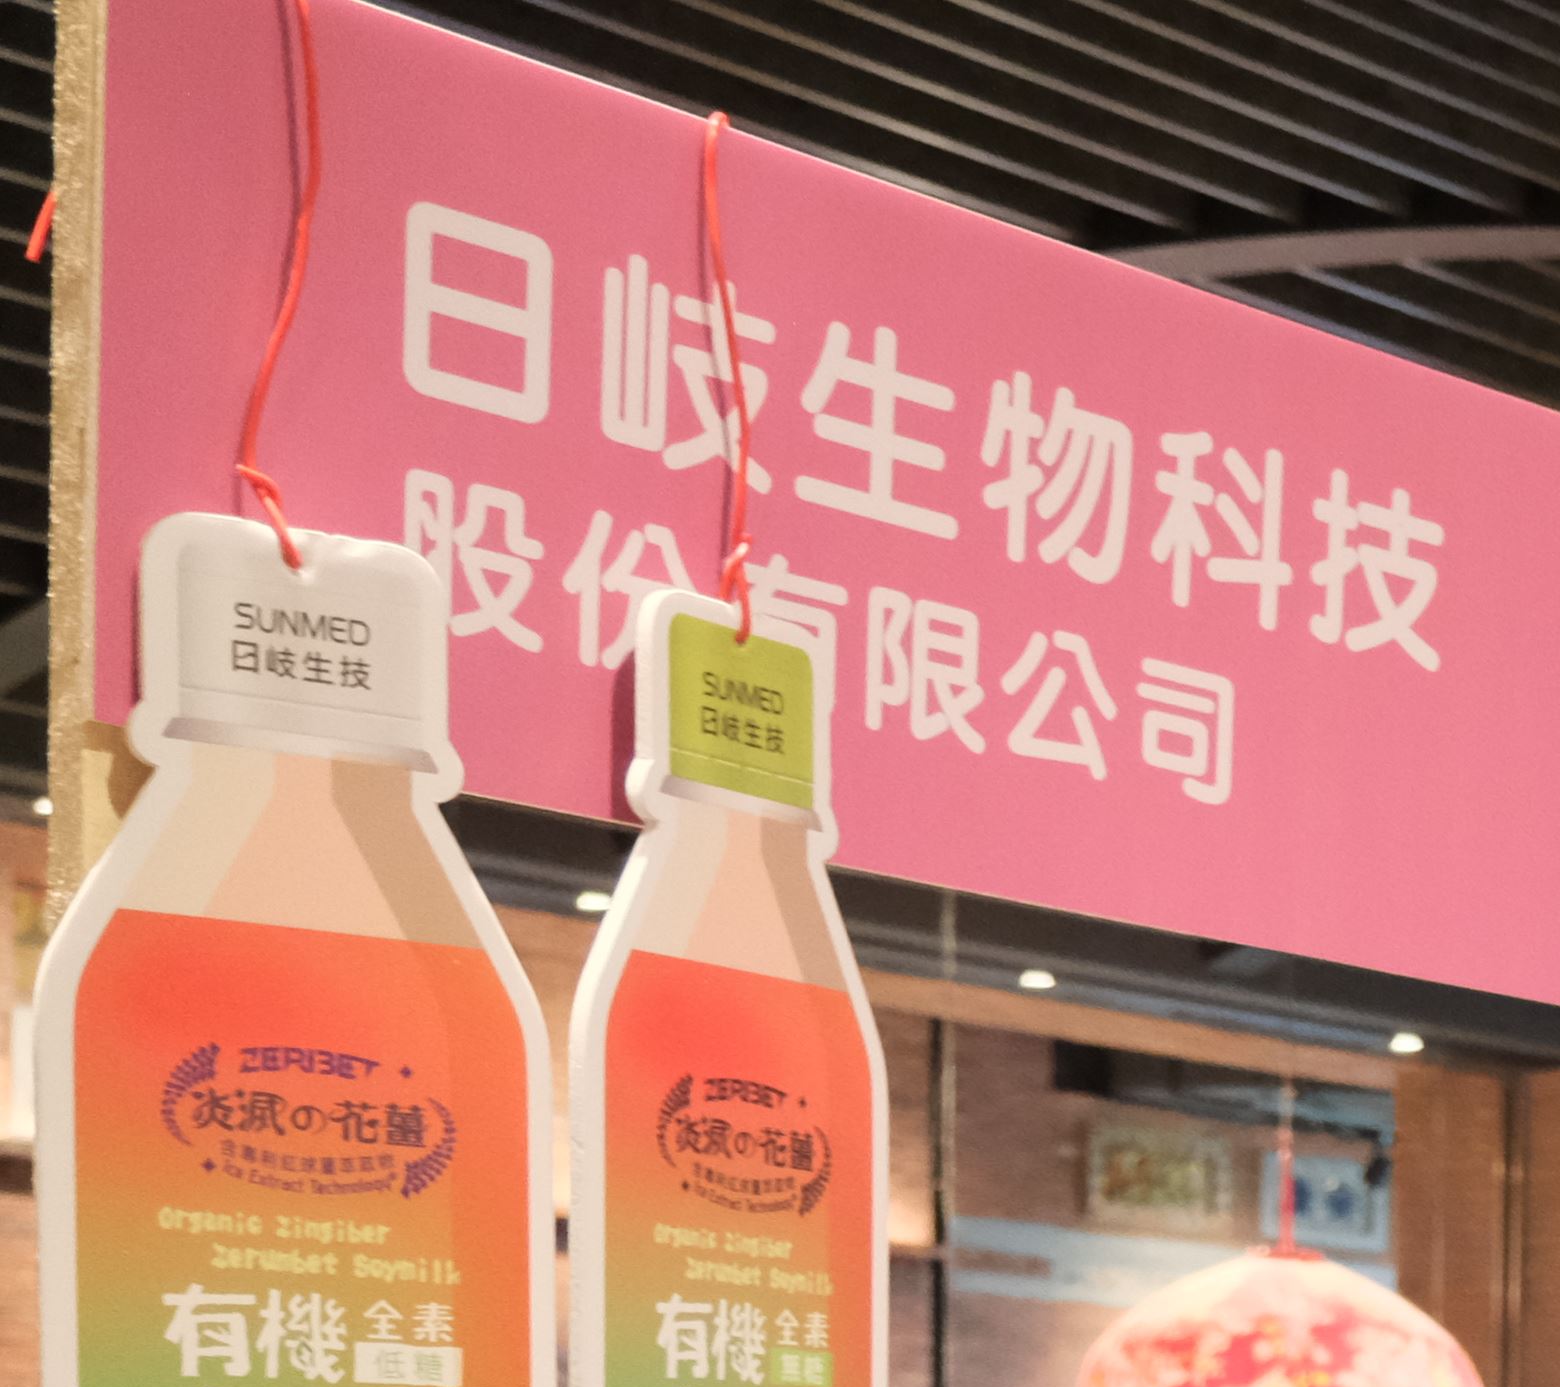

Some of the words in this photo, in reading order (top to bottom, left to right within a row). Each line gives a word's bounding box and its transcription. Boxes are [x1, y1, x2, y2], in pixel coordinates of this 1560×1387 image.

[402, 200, 1447, 671] 日岐生物科技
[231, 600, 371, 648] SUNMED
[229, 638, 373, 693] 日岐生技
[702, 671, 784, 716] SUNMED
[700, 706, 786, 754] 日岐生技
[158, 1206, 263, 1235] Organic
[275, 1215, 391, 1245] Zingiber
[211, 1242, 338, 1275] Zerumbet
[353, 1253, 462, 1285] Soymilk
[161, 1283, 347, 1384] 有機
[363, 1300, 455, 1342] 全素
[655, 1293, 767, 1385] 有機
[774, 1308, 829, 1348] 全素
